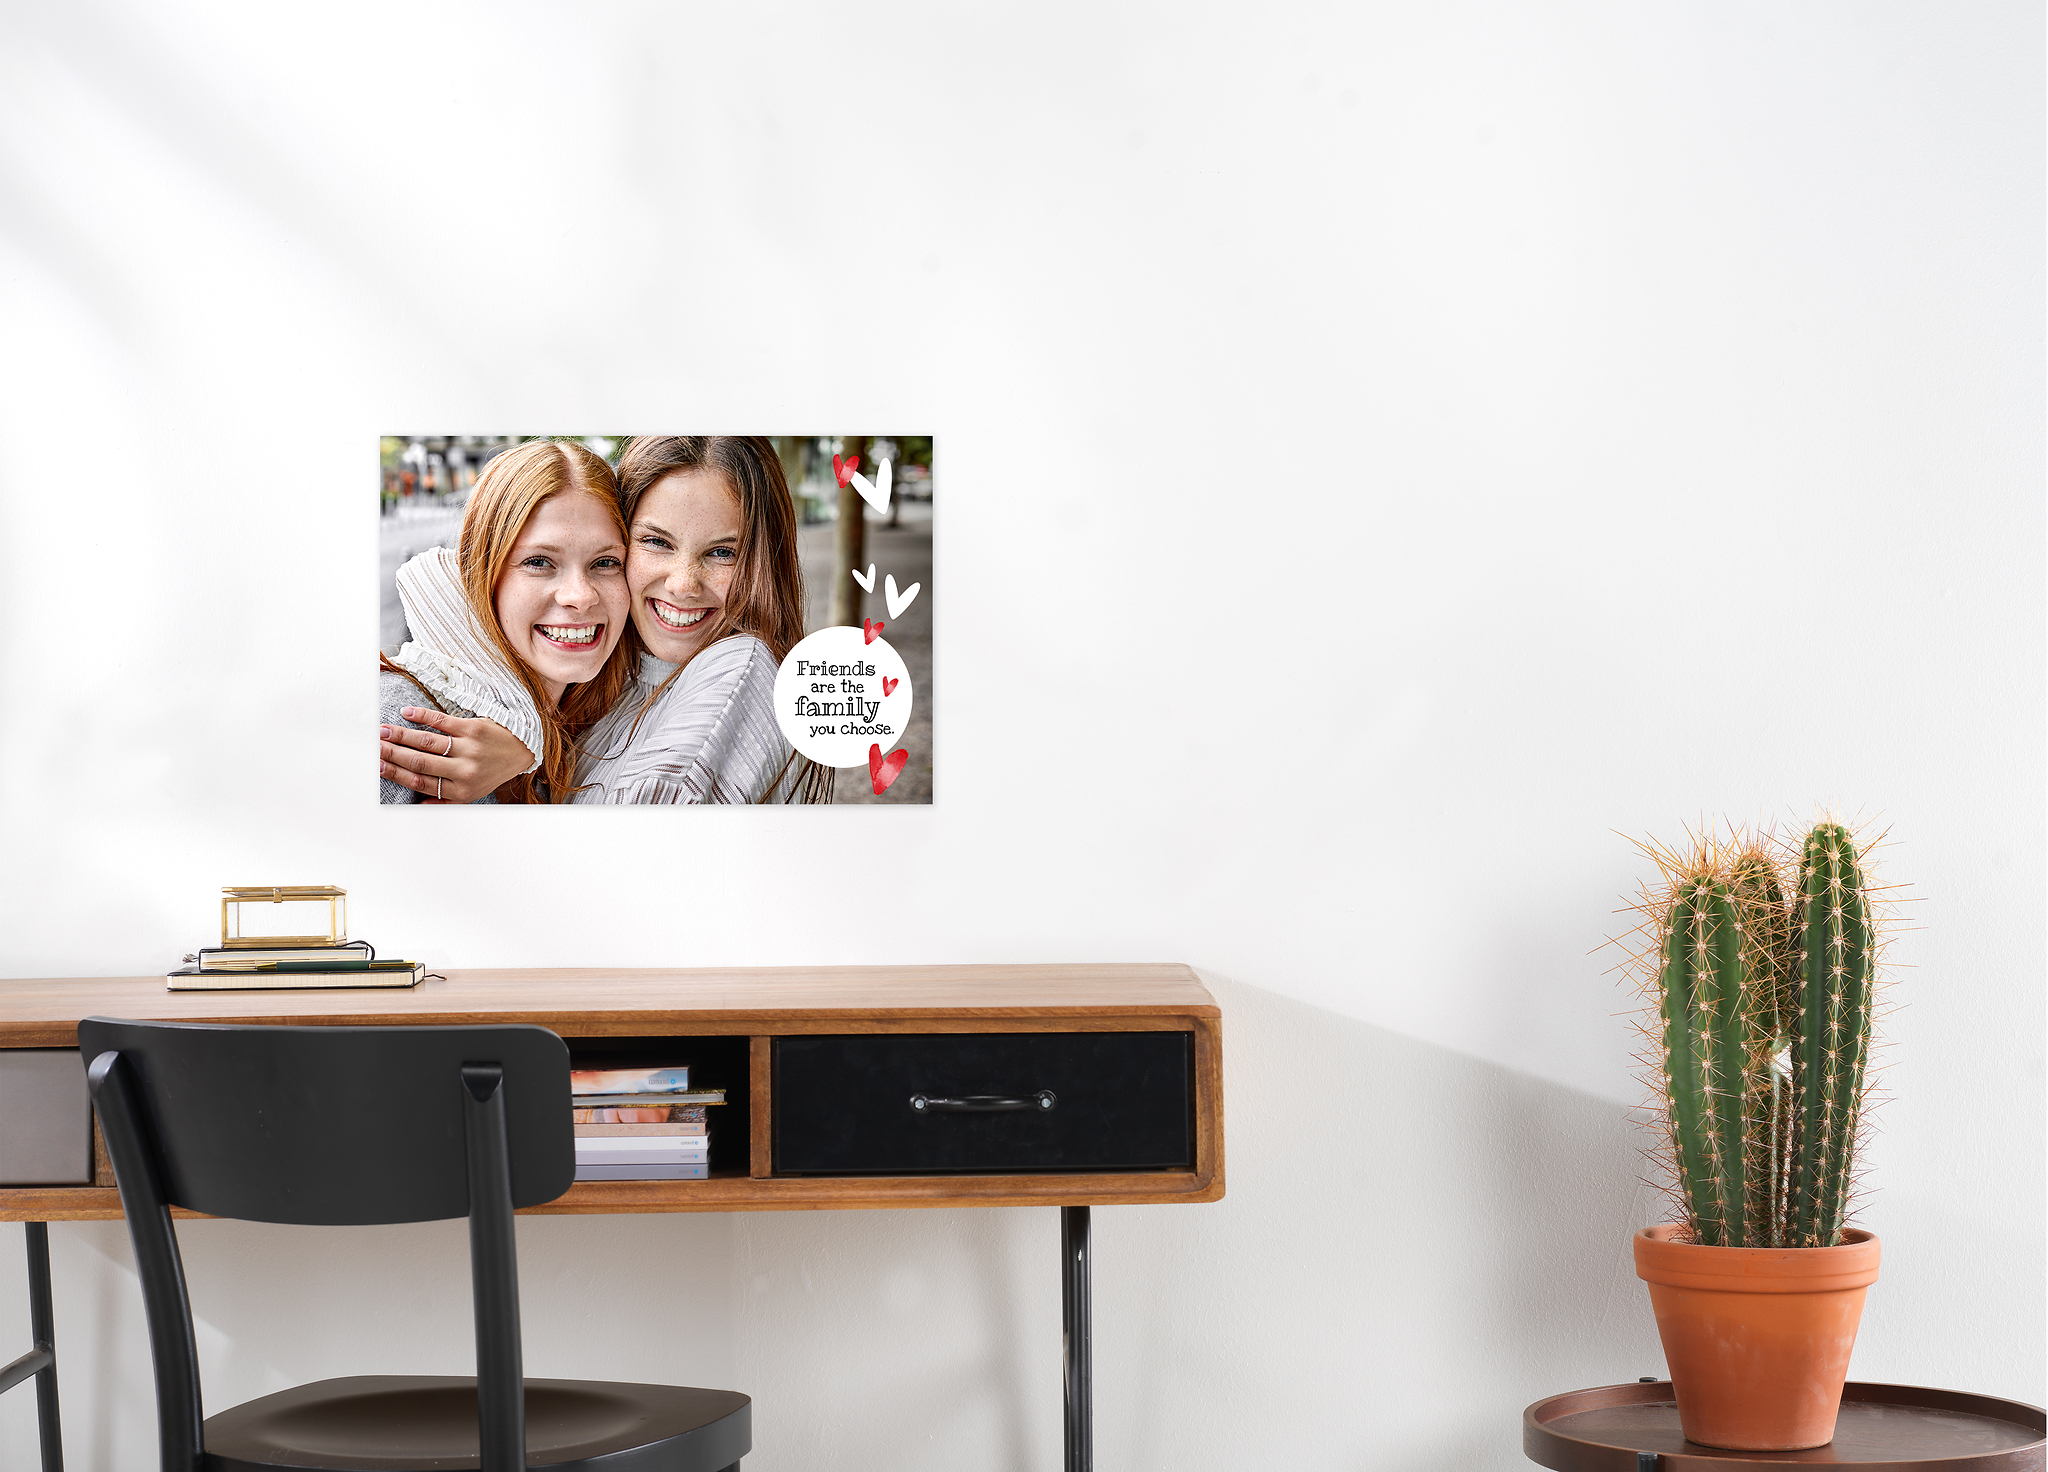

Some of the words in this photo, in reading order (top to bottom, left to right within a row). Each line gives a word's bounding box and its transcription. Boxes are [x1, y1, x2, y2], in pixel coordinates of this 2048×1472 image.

[796, 660, 876, 676] Friends
[810, 682, 836, 693] are
[840, 679, 865, 693] the
[795, 695, 881, 723] family
[809, 725, 836, 738] you
[840, 722, 895, 735] choose.
